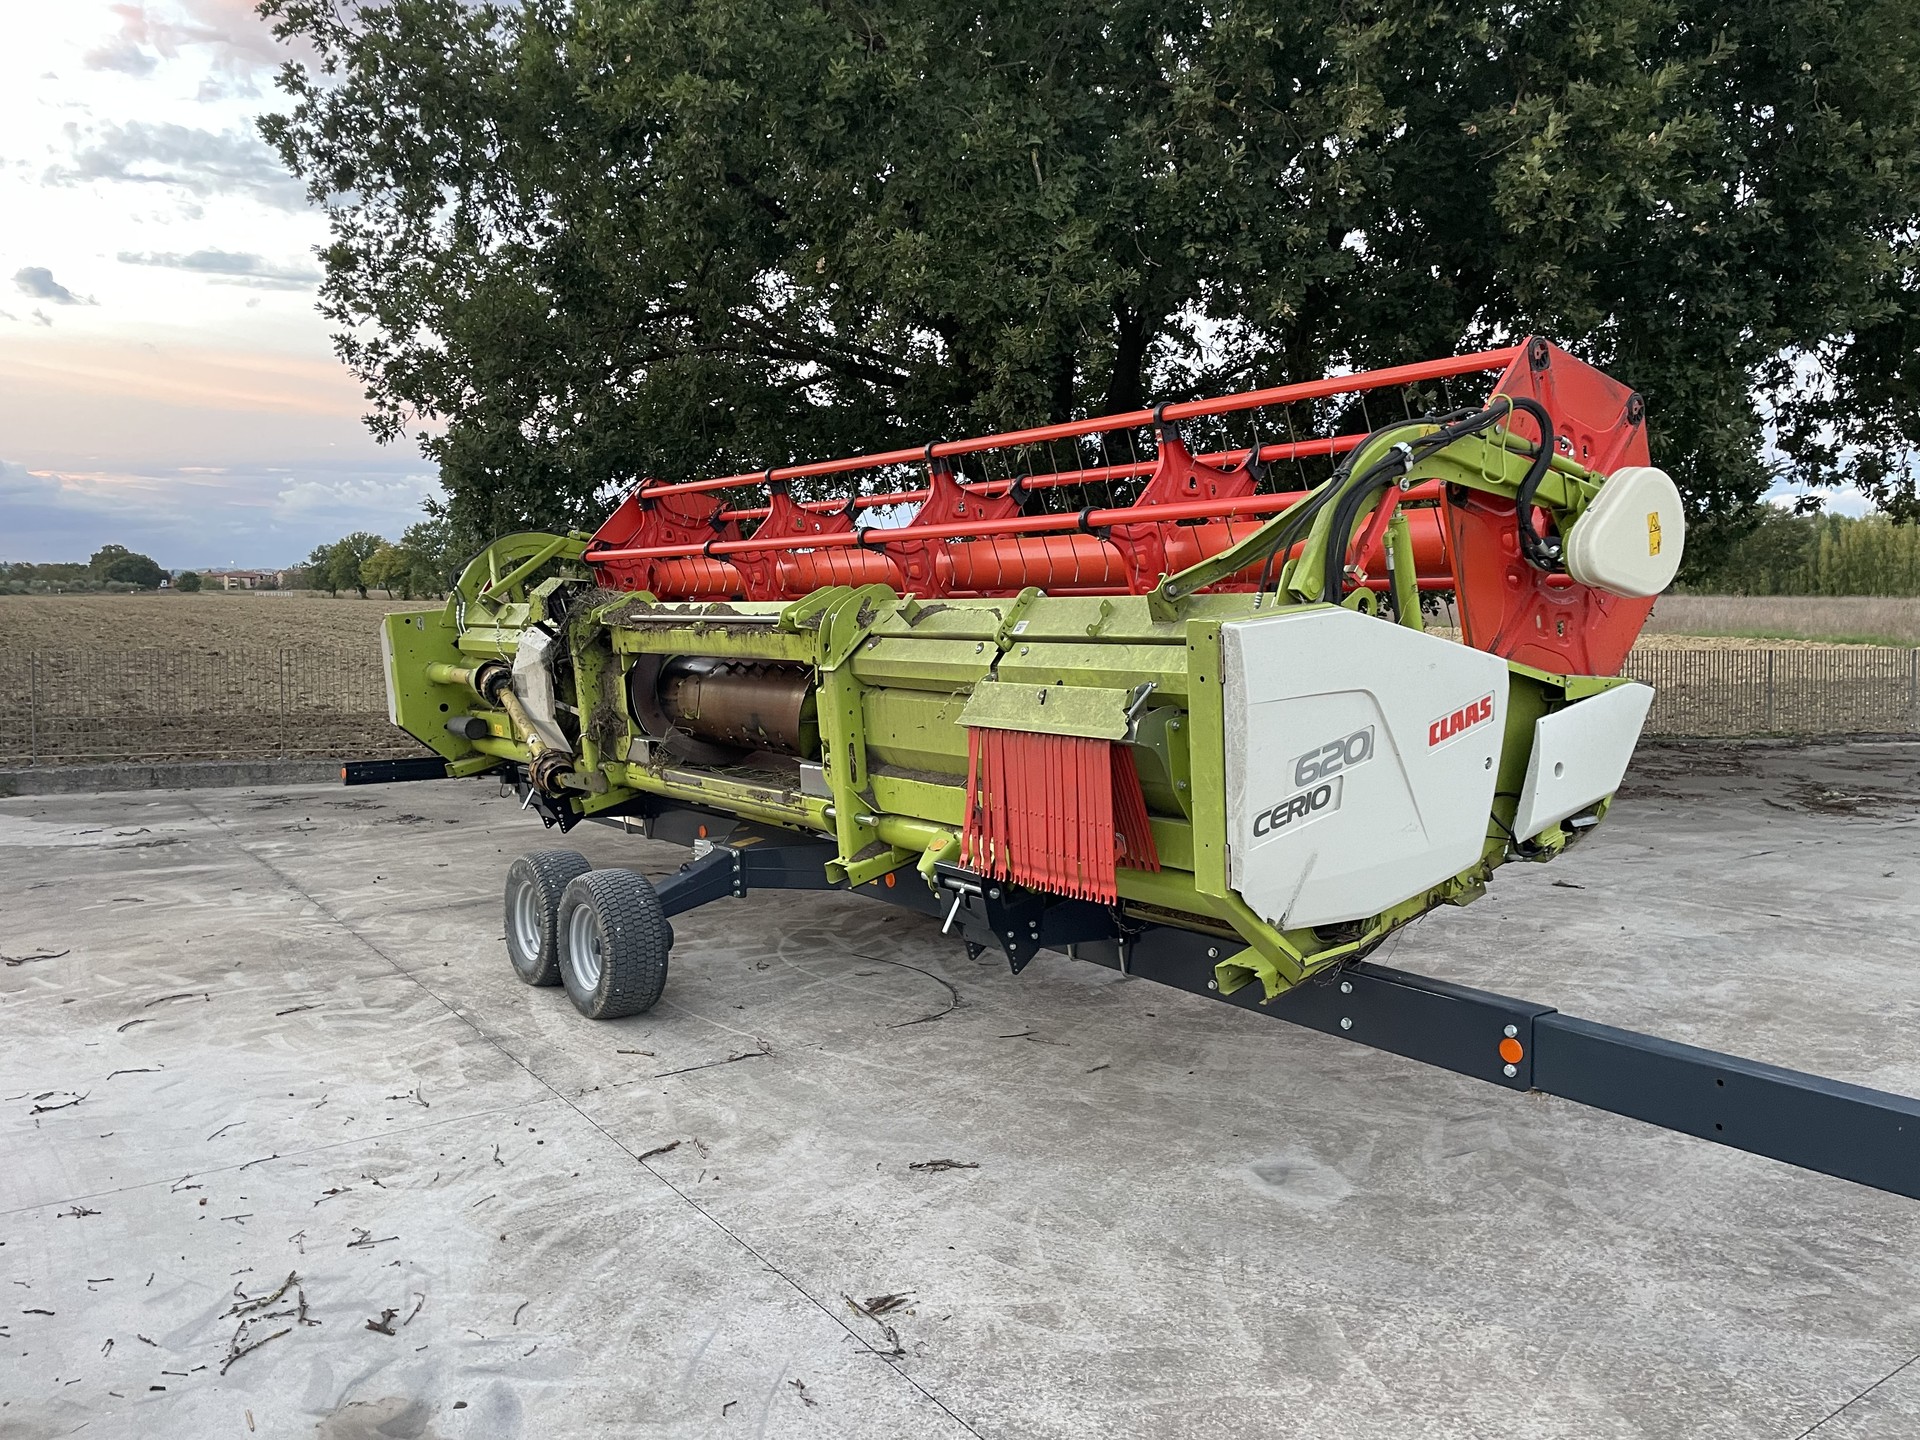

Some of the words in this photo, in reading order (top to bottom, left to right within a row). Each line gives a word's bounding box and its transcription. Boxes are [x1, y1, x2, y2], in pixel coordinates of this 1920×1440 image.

[1428, 696, 1491, 747] CLAAS
[1295, 731, 1370, 787] 620
[1253, 785, 1331, 837] CERIO
